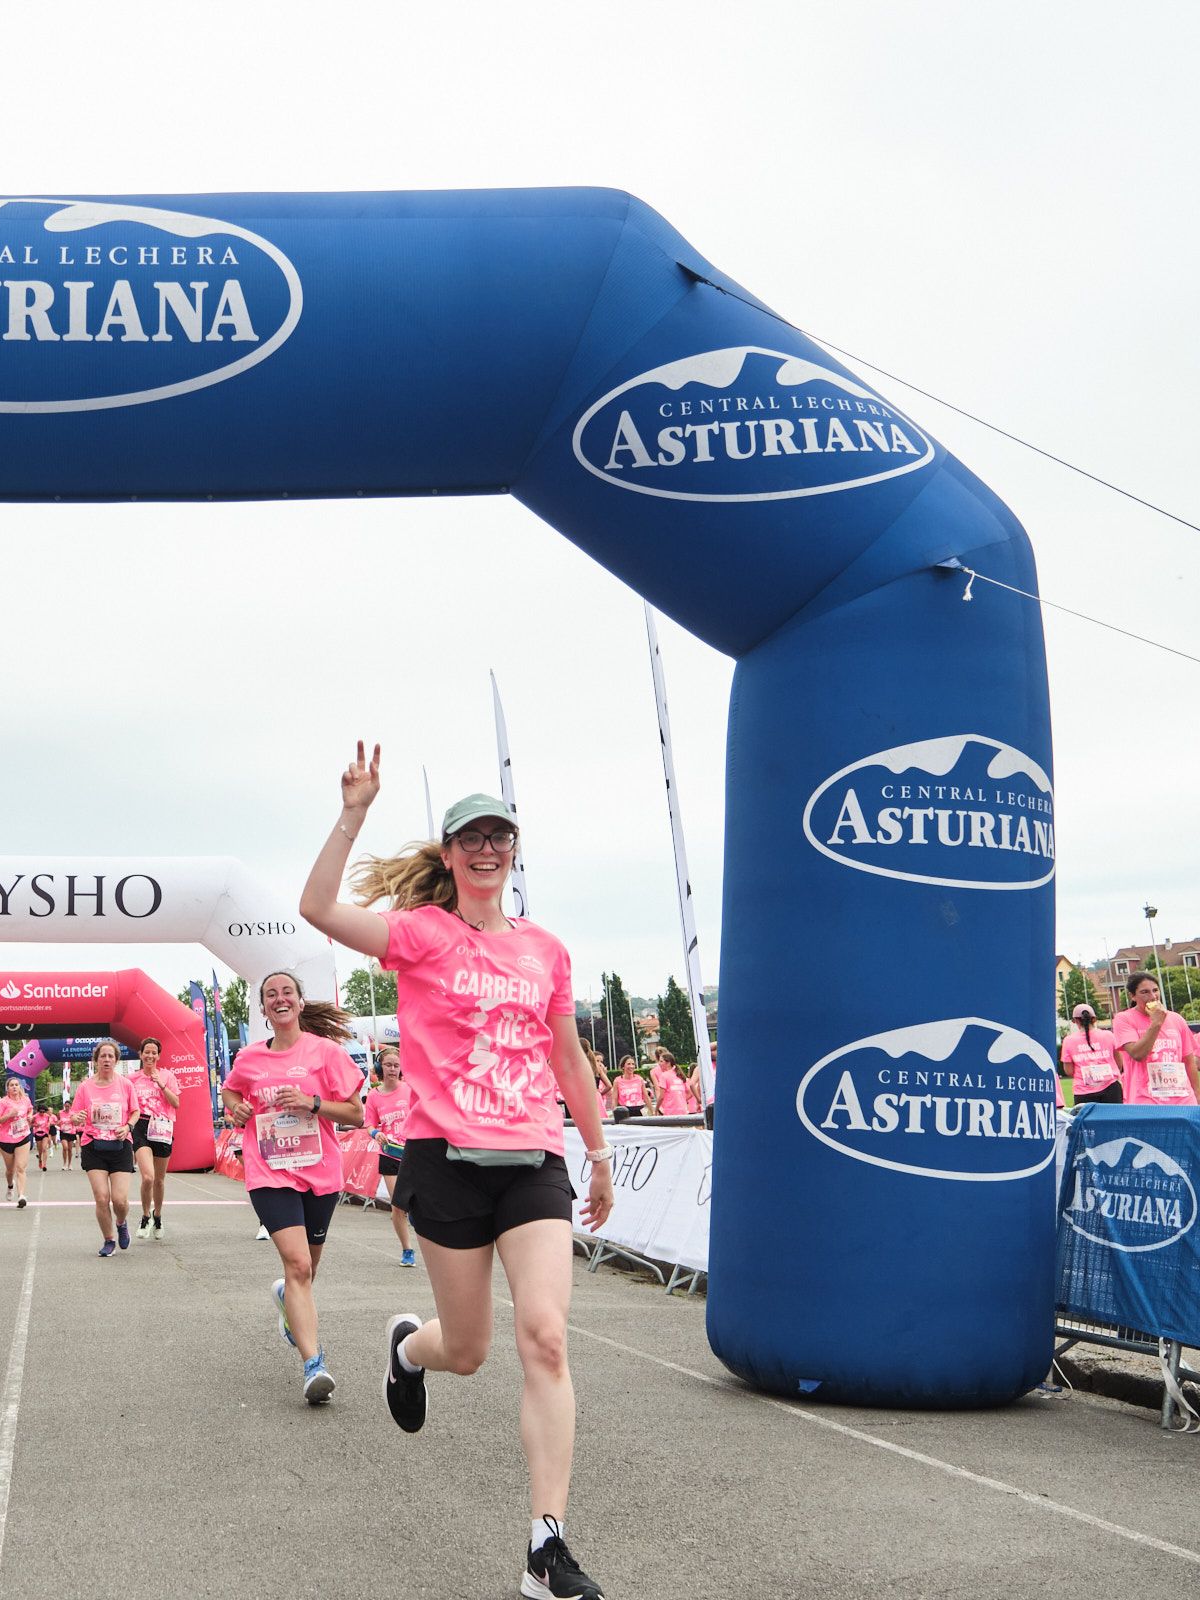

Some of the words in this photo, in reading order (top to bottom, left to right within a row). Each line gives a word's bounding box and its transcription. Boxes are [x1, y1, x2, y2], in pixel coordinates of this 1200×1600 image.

[59, 244, 240, 266] LECHERA
[659, 396, 781, 418] CENTRAL
[792, 395, 893, 419] LECHERA
[604, 410, 921, 470] ASTURIANA
[881, 785, 987, 802] CENTRAL
[996, 790, 1053, 815] LECHERA
[826, 788, 1056, 860] ASTURIANA
[228, 921, 296, 937] OYSHO
[23, 983, 109, 999] Santander
[453, 969, 540, 1008] CARRERA
[171, 1054, 196, 1063] Sports
[878, 1069, 986, 1089] CENTRAL
[996, 1075, 1054, 1094] LECHERA
[820, 1070, 1056, 1141] ASTURIANA
[277, 1136, 301, 1148] 016
[1134, 1177, 1182, 1193] LECHERA
